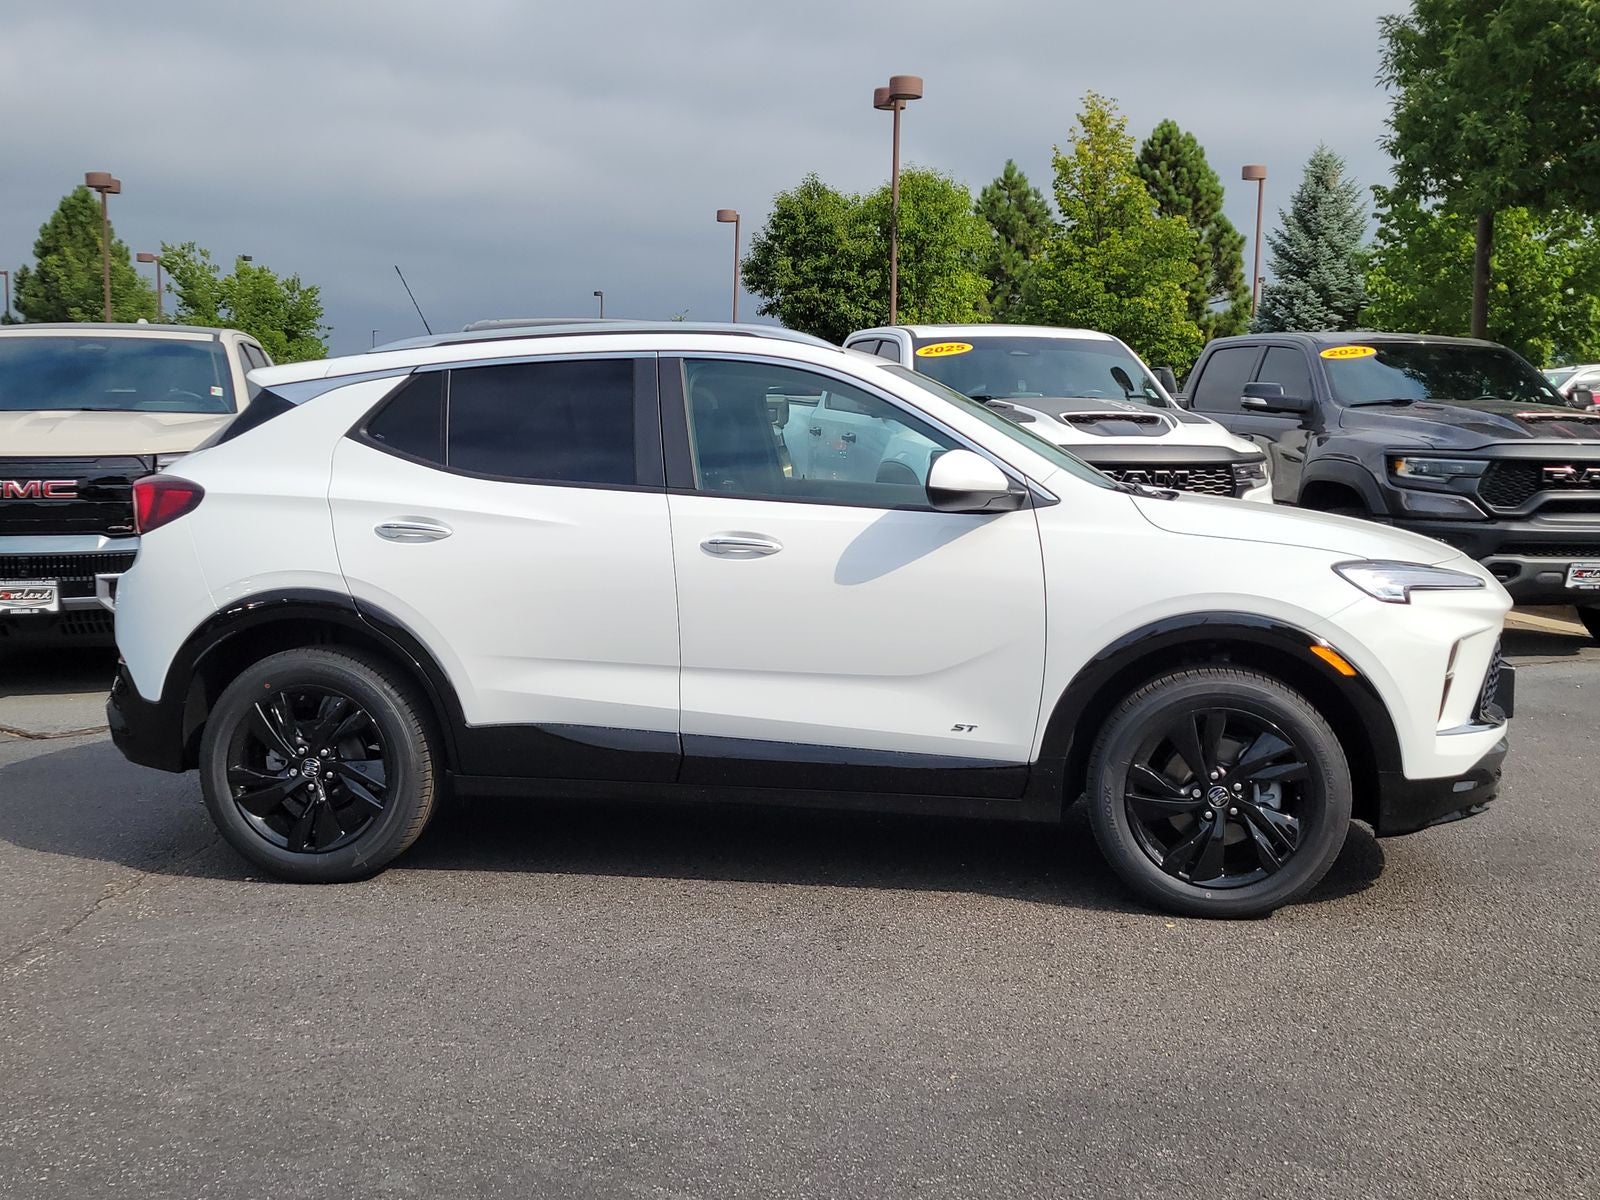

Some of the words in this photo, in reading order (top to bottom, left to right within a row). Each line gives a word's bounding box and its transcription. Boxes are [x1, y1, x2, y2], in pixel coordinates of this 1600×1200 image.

[923, 345, 966, 355] 2025
[1327, 349, 1368, 357] 2021
[1543, 467, 1600, 483] RA
[0, 480, 78, 499] MC
[0, 588, 52, 600] oveland
[950, 723, 978, 733] ST
